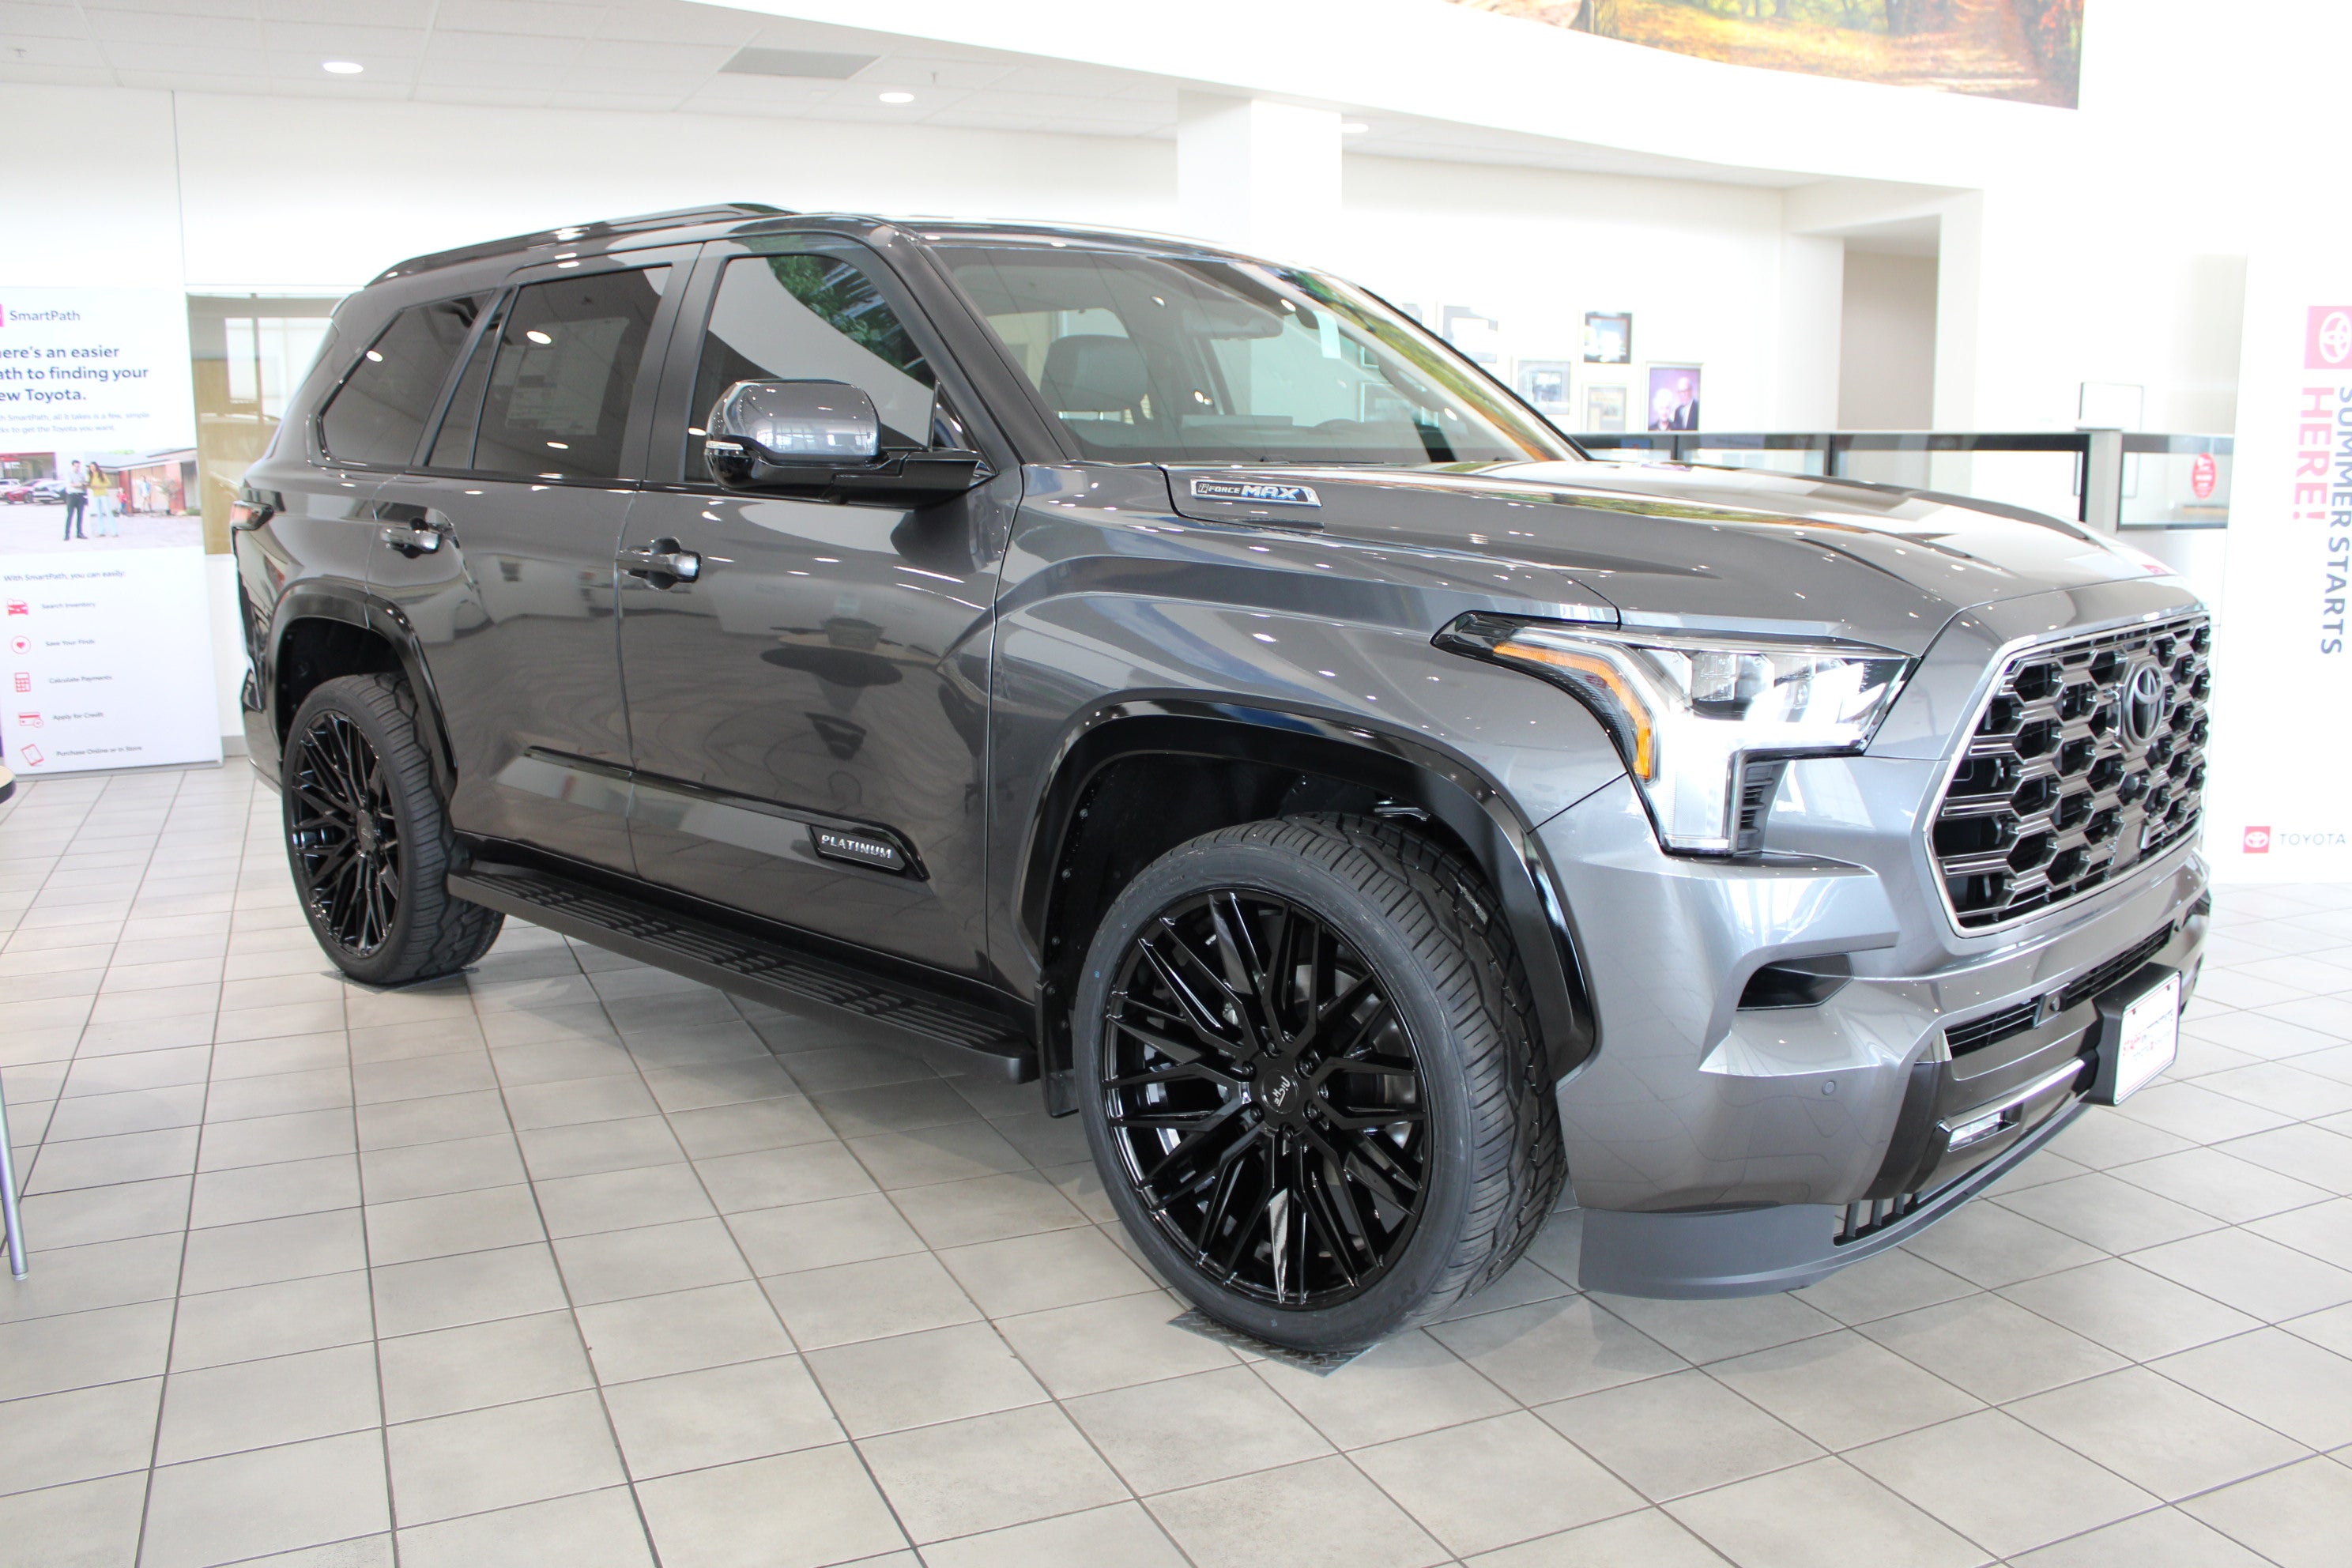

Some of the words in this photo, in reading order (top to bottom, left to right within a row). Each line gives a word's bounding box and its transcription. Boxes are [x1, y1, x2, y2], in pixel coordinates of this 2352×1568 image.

[9, 310, 81, 321] SmartPath
[0, 345, 41, 358] ere's
[47, 349, 66, 358] an
[71, 345, 119, 358] easier
[27, 368, 45, 379] to
[50, 366, 108, 382] finding
[112, 369, 149, 382] your
[24, 388, 86, 404] Toyota.
[2293, 387, 2335, 519] HERE!
[1241, 484, 1300, 500] MAX
[2320, 537, 2350, 654] STARTS
[821, 834, 892, 859] PLATINUM
[2279, 833, 2346, 846] TOYOTA
